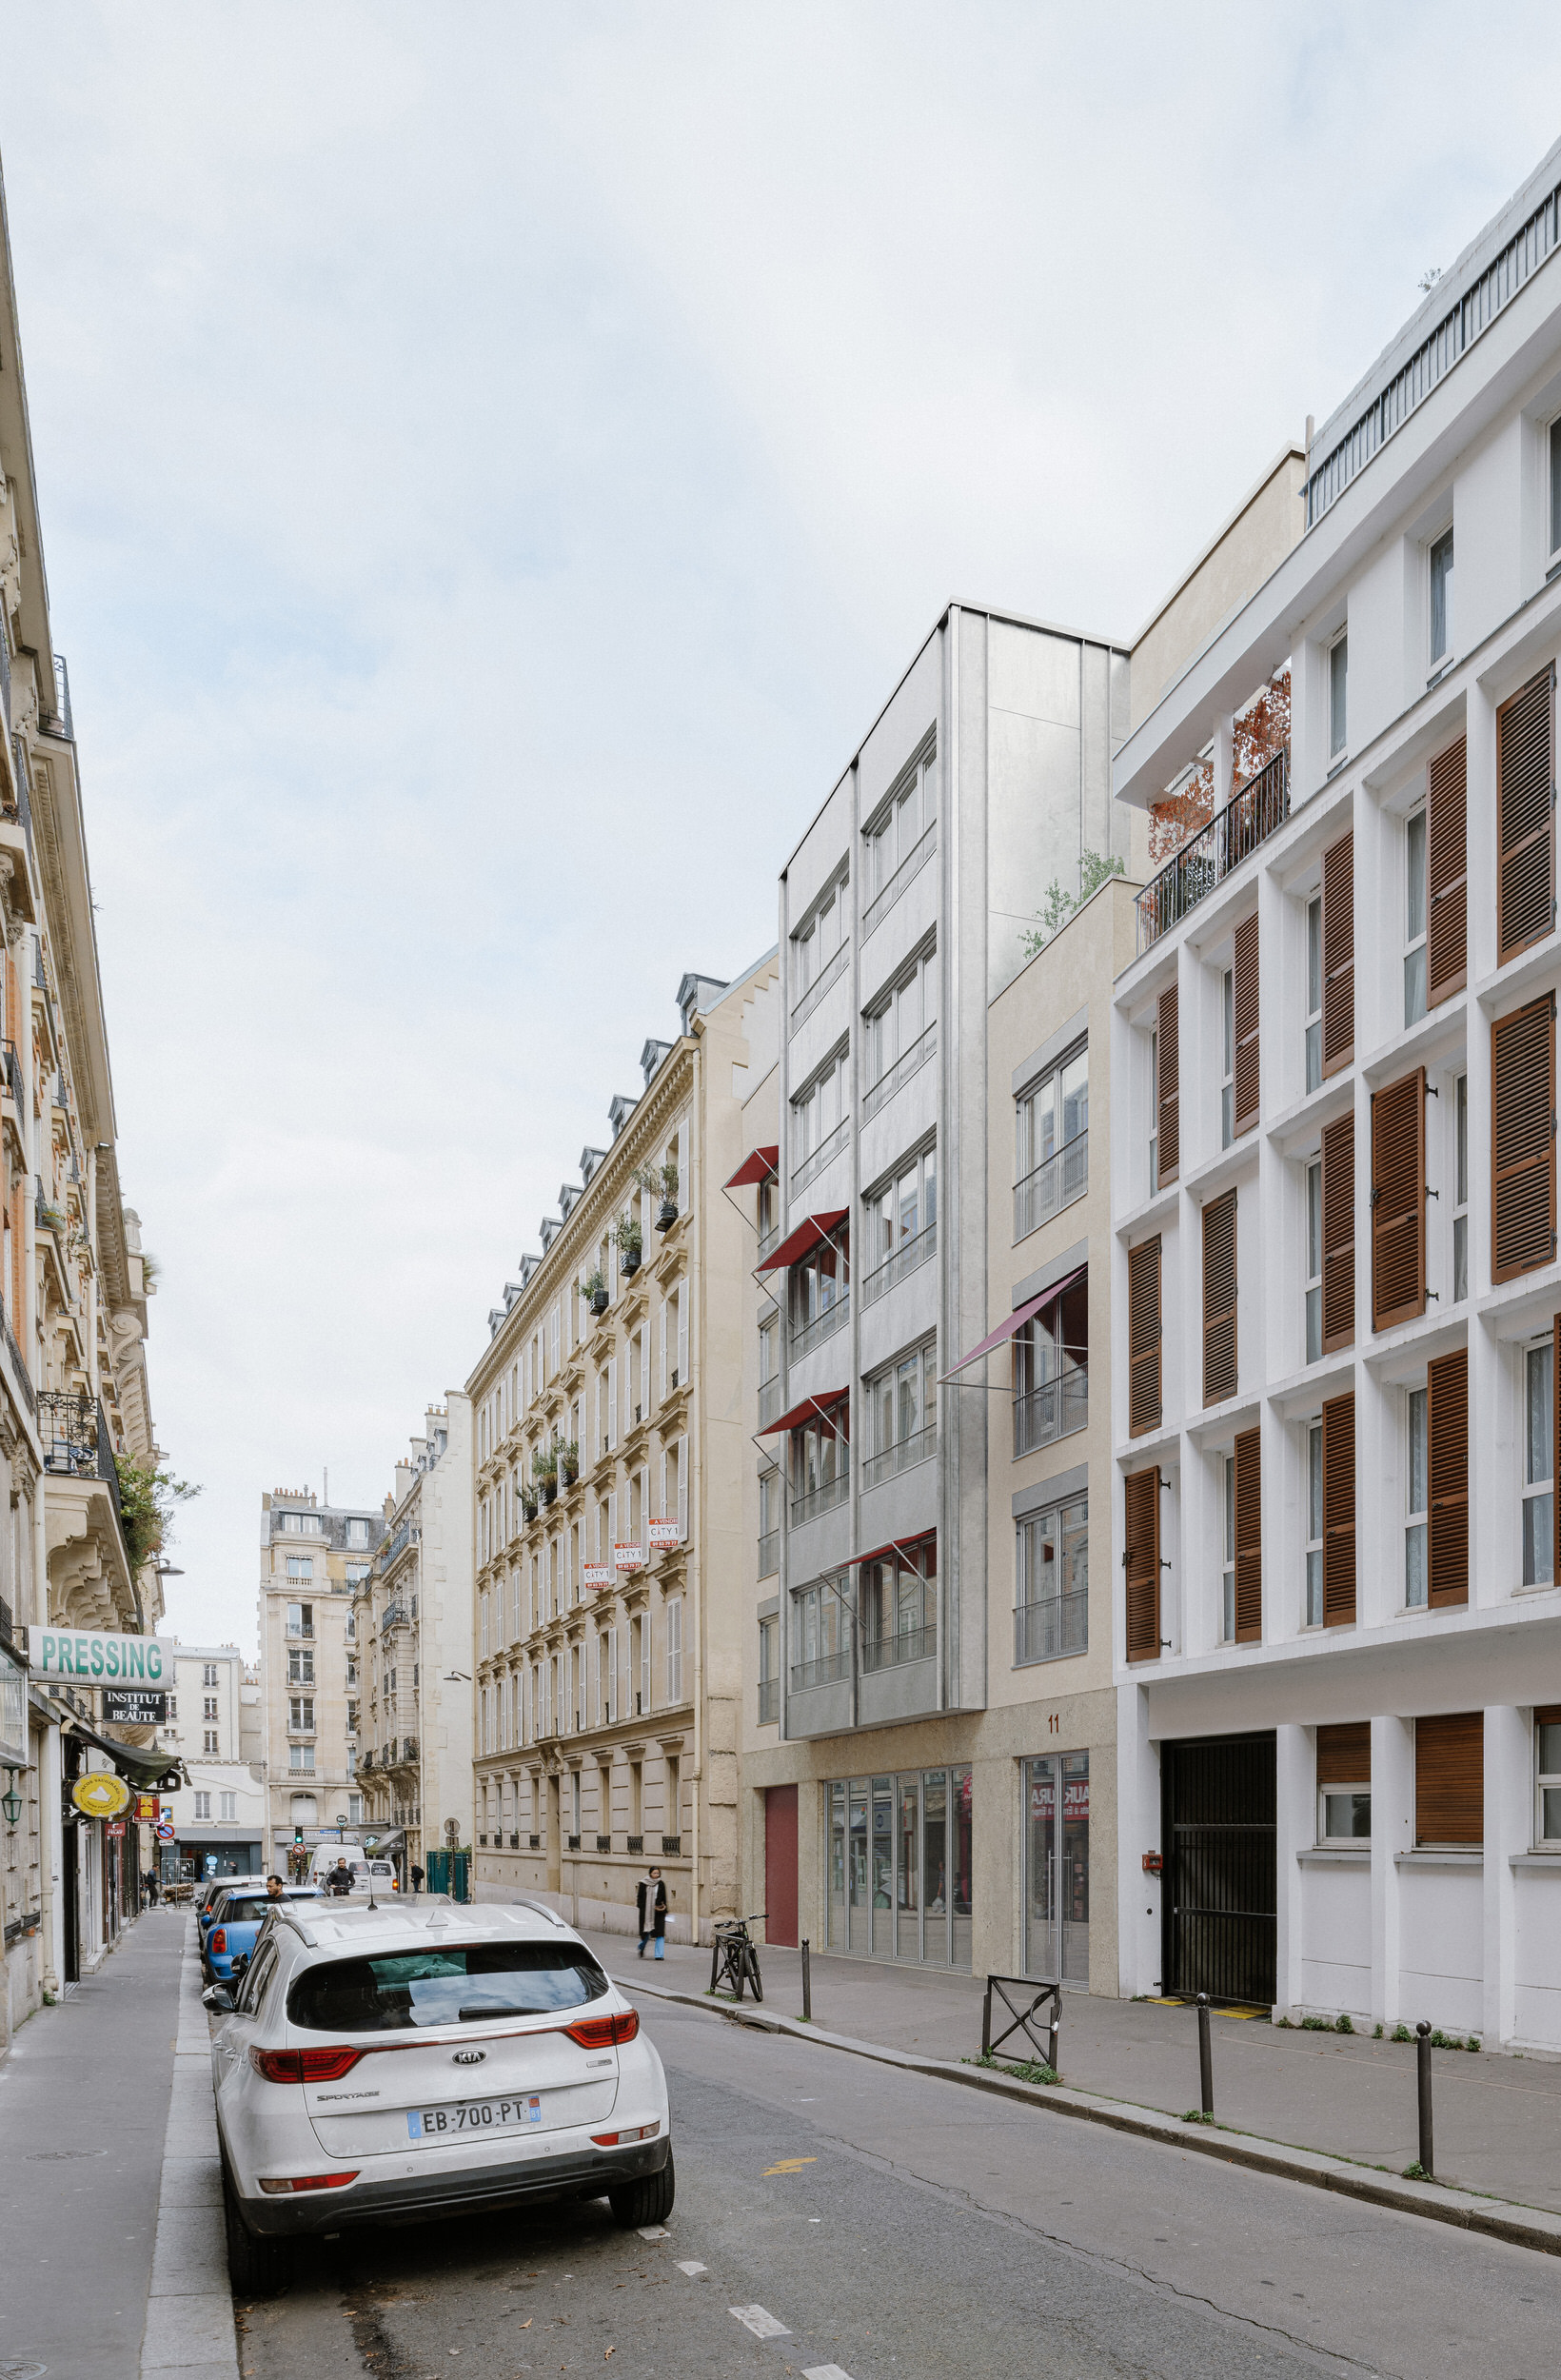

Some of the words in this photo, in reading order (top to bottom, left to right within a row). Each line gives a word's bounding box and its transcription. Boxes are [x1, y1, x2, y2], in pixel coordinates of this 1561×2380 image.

[42, 1636, 162, 1679] PRESSING
[108, 1693, 162, 1704] INSTITUT
[112, 1711, 156, 1721] BEAUTE
[1048, 1714, 1059, 1734] 11
[458, 2052, 482, 2064] KIA
[317, 2091, 380, 2102] SPORTAGE
[423, 2100, 524, 2133] EB-700-PT
